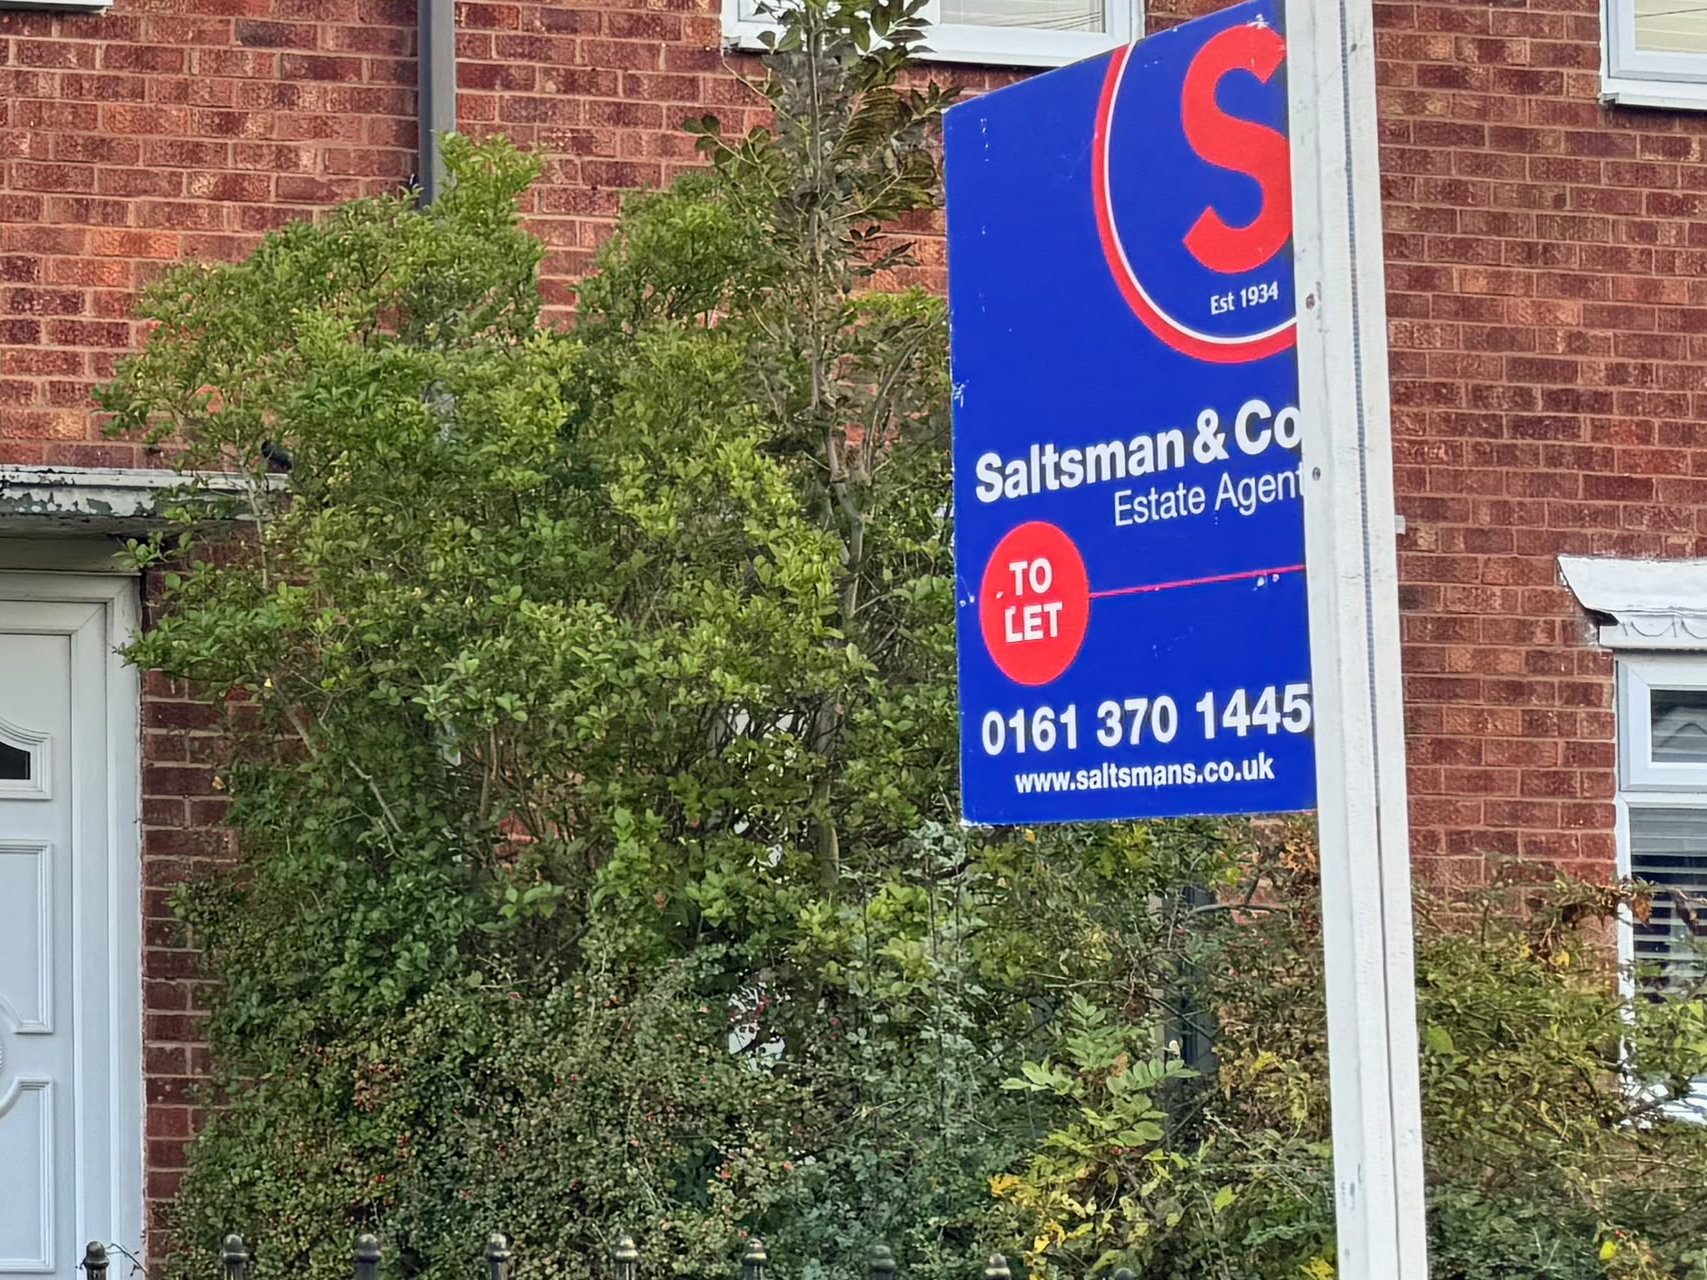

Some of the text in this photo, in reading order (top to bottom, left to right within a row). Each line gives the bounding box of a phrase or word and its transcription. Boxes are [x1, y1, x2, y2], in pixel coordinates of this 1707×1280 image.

[1181, 25, 1293, 273] S
[1210, 280, 1279, 315] Est 1934
[975, 399, 1302, 503] Saltsman & Co
[1114, 484, 1205, 526] Estate
[1008, 557, 1053, 596] TO
[1003, 601, 1063, 644] LET
[981, 682, 1312, 756] 0161 370 1445
[1015, 751, 1275, 794] www.saltsmans.co.uk
